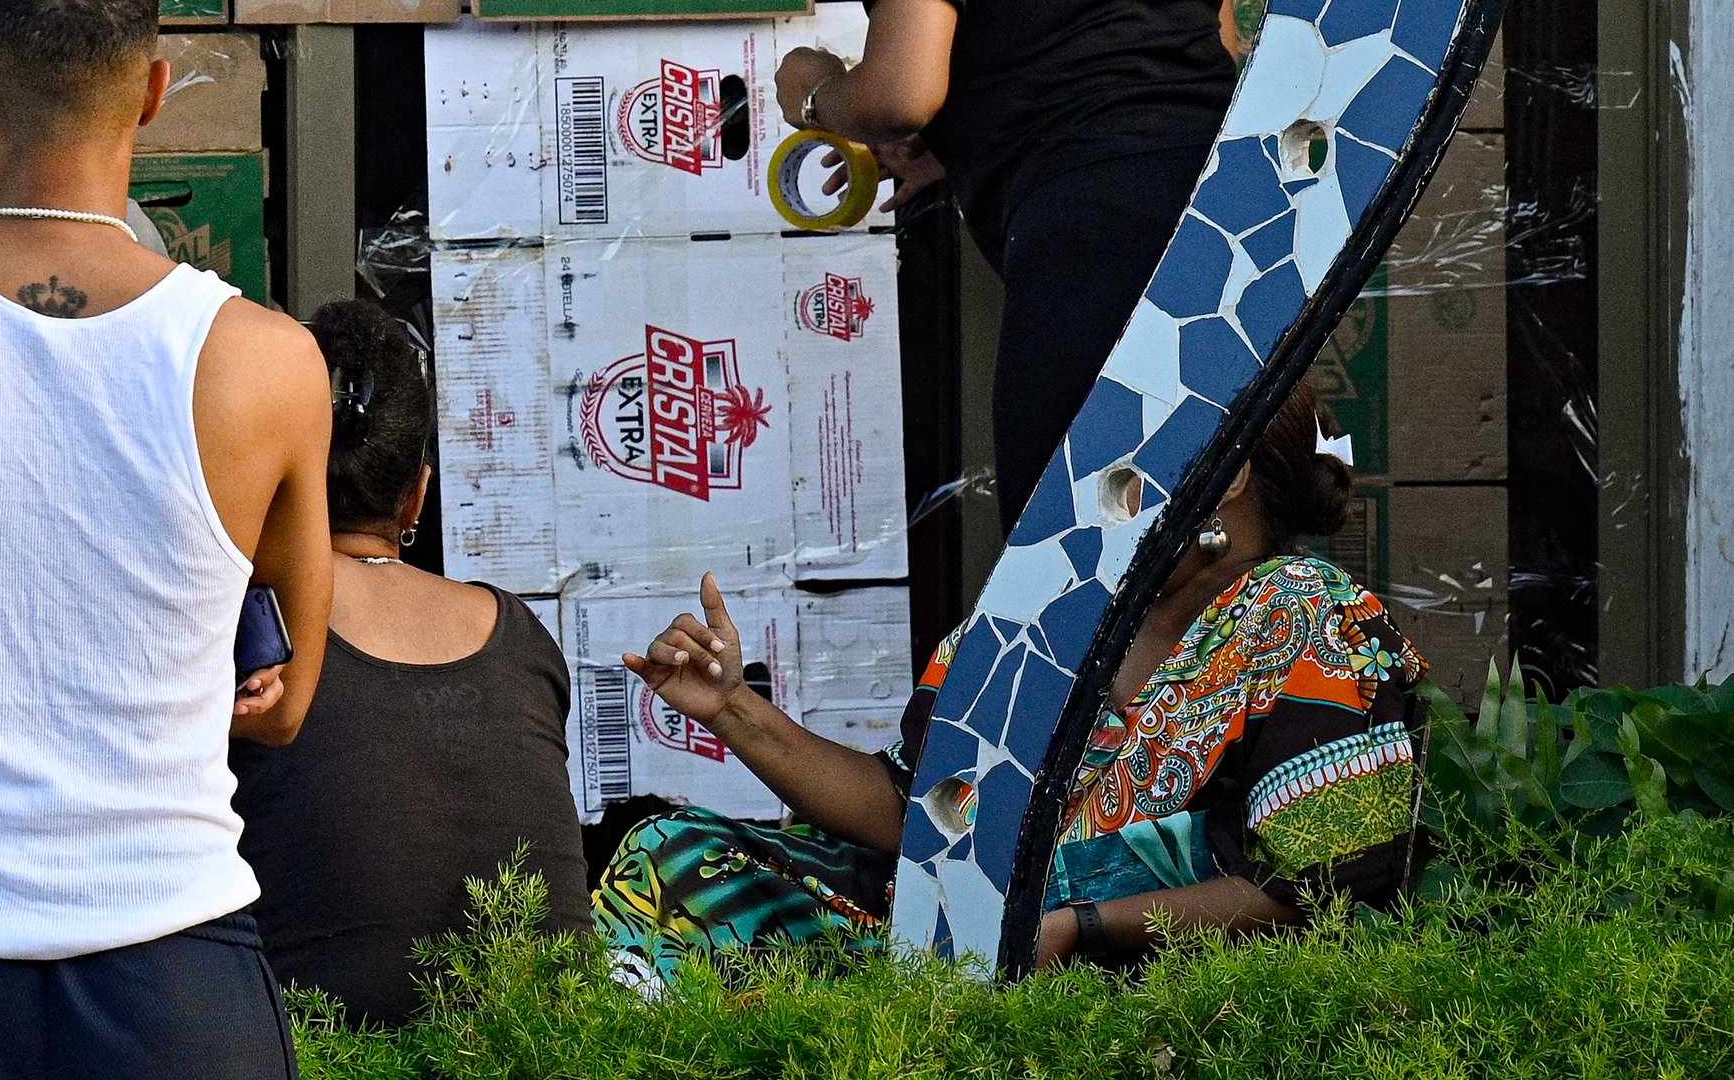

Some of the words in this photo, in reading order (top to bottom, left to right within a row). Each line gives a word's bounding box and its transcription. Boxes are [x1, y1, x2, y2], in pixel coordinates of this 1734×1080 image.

[639, 93, 658, 150] EXTRA
[665, 63, 696, 166] CRISTAL
[560, 102, 573, 202] 18500001275074
[561, 256, 571, 271] 24
[813, 292, 825, 326] EXTRA
[827, 275, 846, 335] CRISTAL
[616, 377, 645, 463] EXTRA
[650, 331, 697, 482] CRISTAL
[700, 391, 713, 438] CERVEZA
[584, 689, 597, 791] 18500001275074
